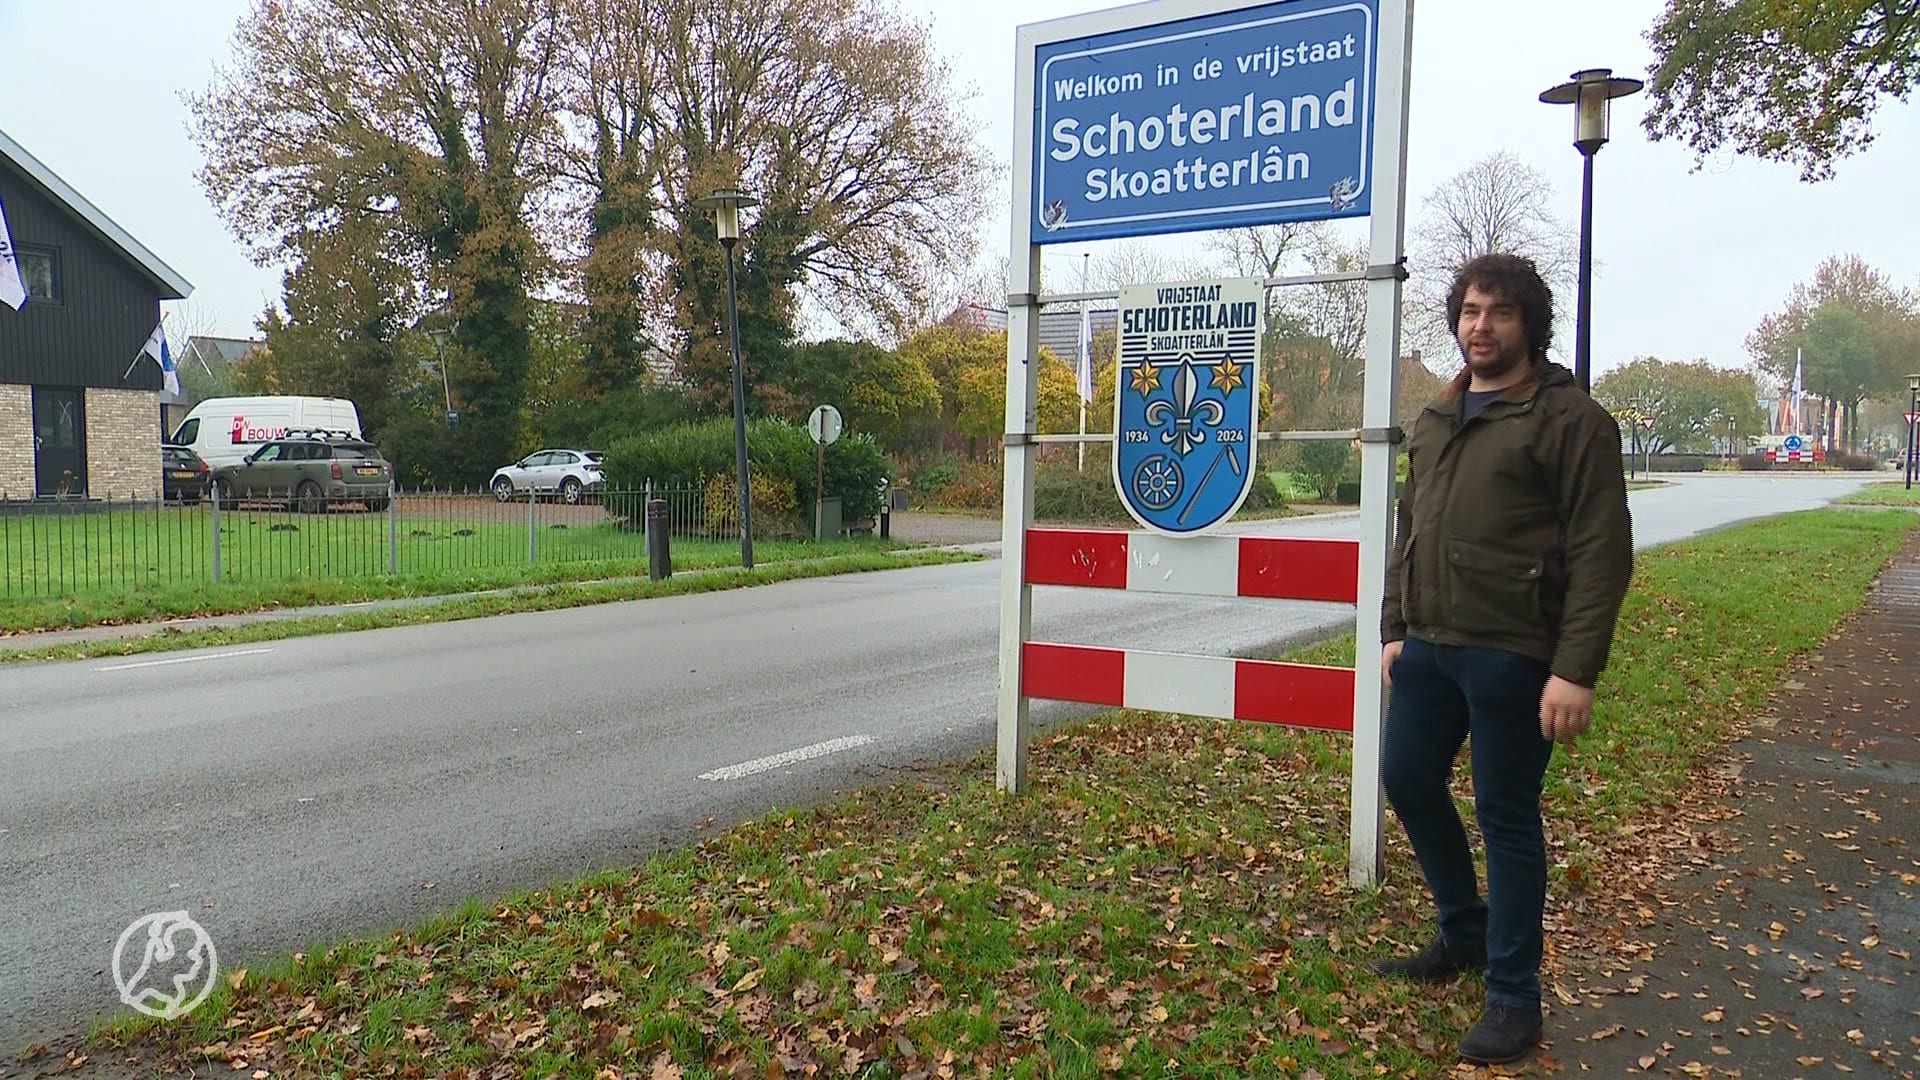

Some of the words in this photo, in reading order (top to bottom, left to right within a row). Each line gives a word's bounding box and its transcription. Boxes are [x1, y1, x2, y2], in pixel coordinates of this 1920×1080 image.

[1054, 72, 1143, 101] Welkom
[1157, 64, 1179, 87] in
[1193, 56, 1223, 81] de
[1237, 33, 1356, 78] vrijstaat
[1050, 78, 1356, 162] Schoterland
[1084, 146, 1310, 202] Skoatterlân
[1157, 285, 1221, 304] VRIJSTAAT
[1123, 302, 1257, 333] SCHOTERLAND
[1151, 331, 1224, 351] SKOATTERLÂN
[248, 428, 286, 440] BOUW
[1125, 430, 1149, 443] 1934
[1216, 430, 1244, 443] 2024
